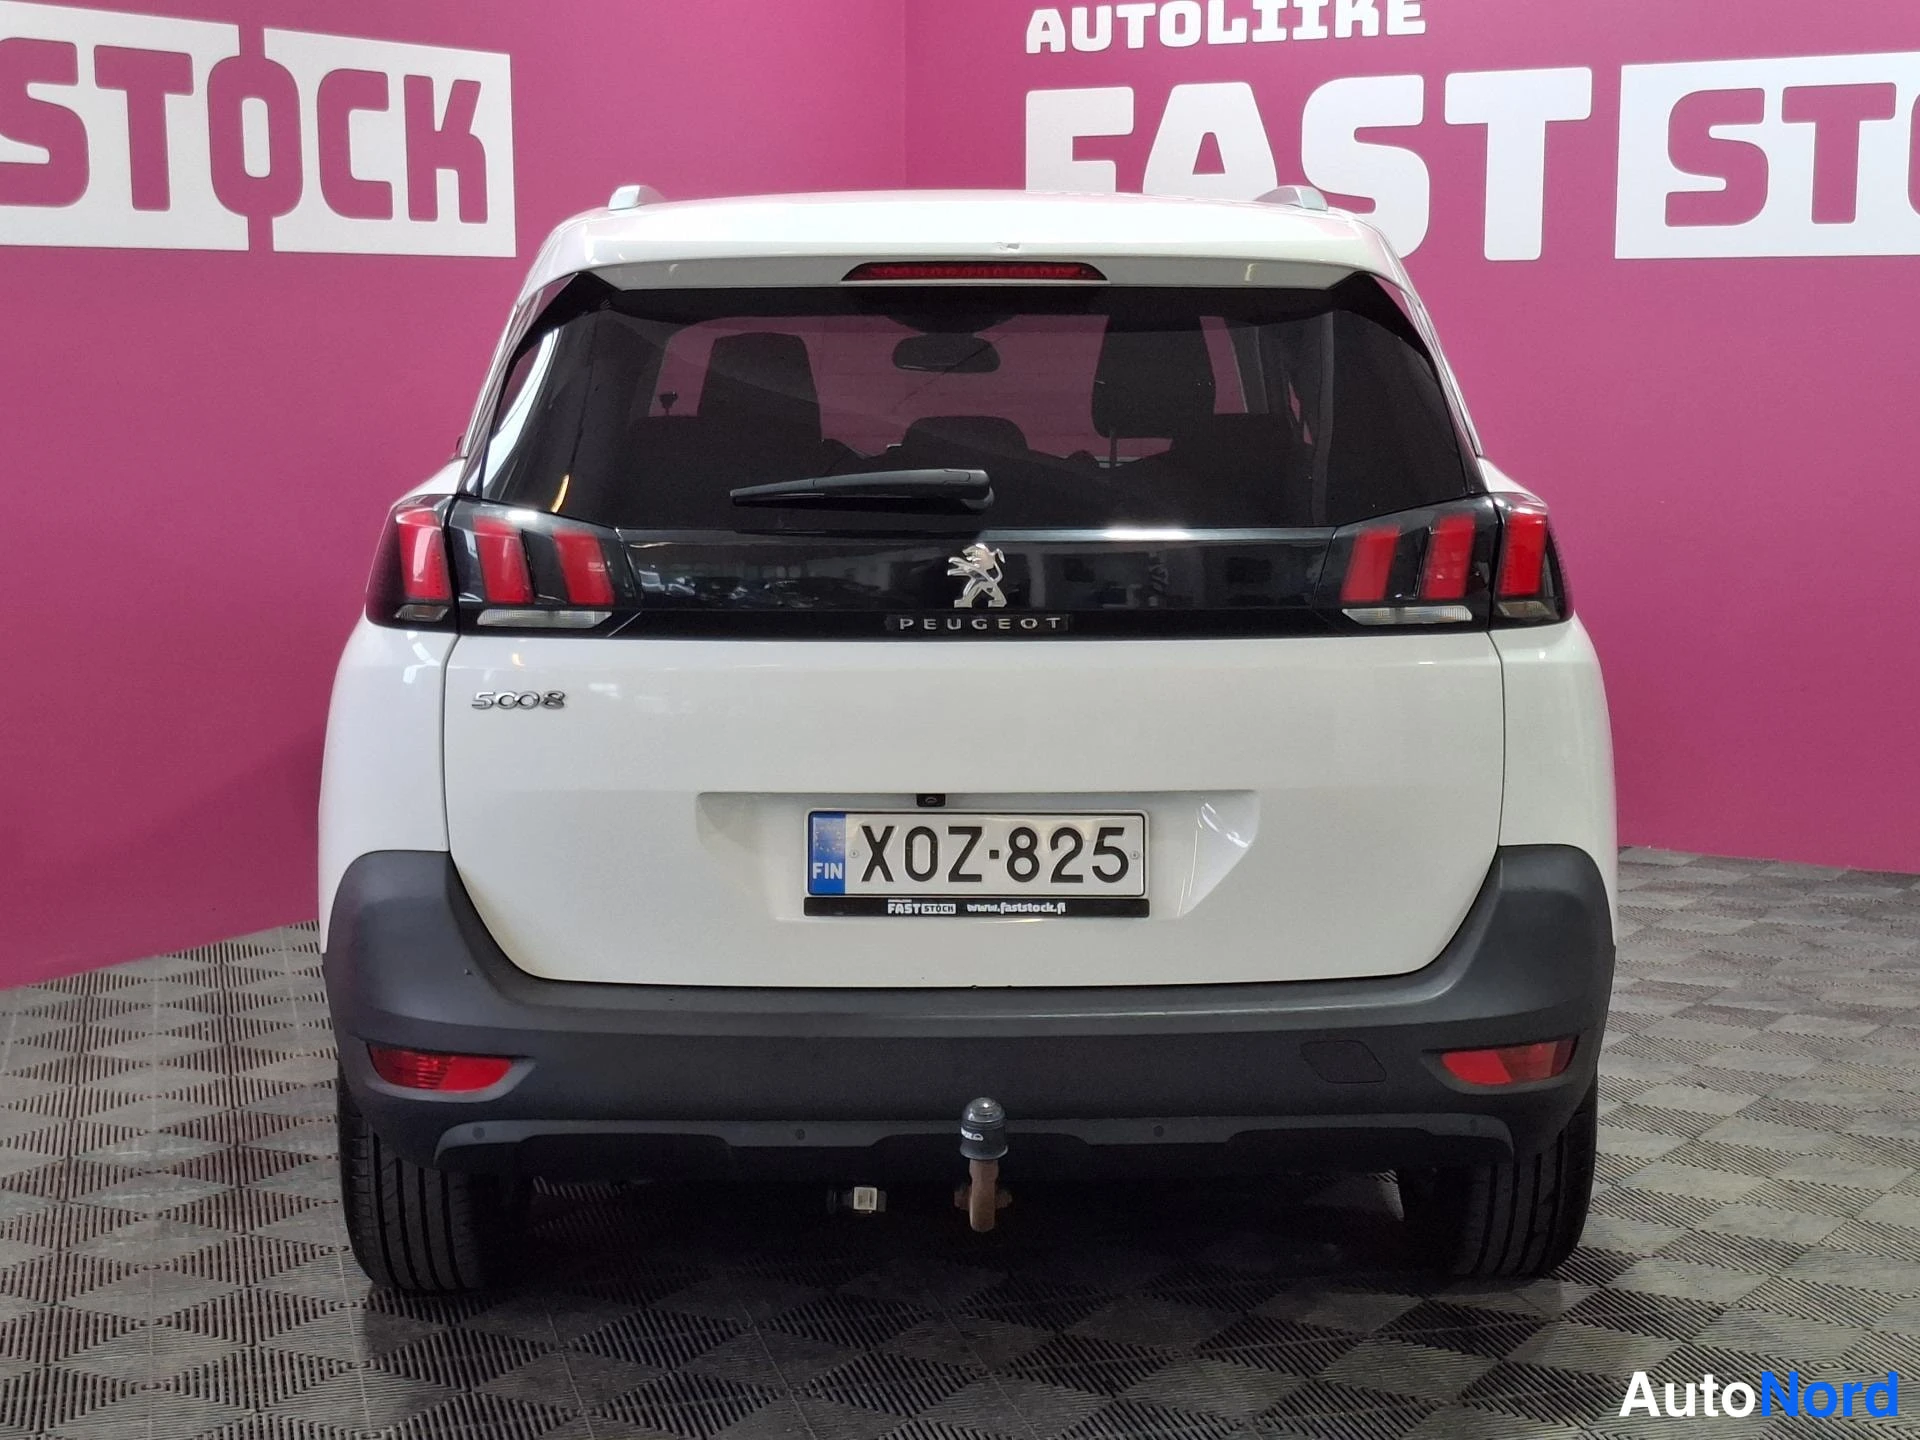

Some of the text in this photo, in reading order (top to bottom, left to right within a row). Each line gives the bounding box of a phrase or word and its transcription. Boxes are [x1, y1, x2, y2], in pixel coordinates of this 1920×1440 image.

[1025, 0, 1427, 54] AUTOLIIKE
[0, 35, 489, 226] STOCK
[1025, 66, 1920, 261] FAST ST
[899, 617, 1062, 631] PEUGEOT
[471, 690, 566, 711] 5008
[812, 862, 844, 881] FIN
[860, 825, 1130, 884] XOZ-825
[966, 902, 1067, 915] www.faststock.fi
